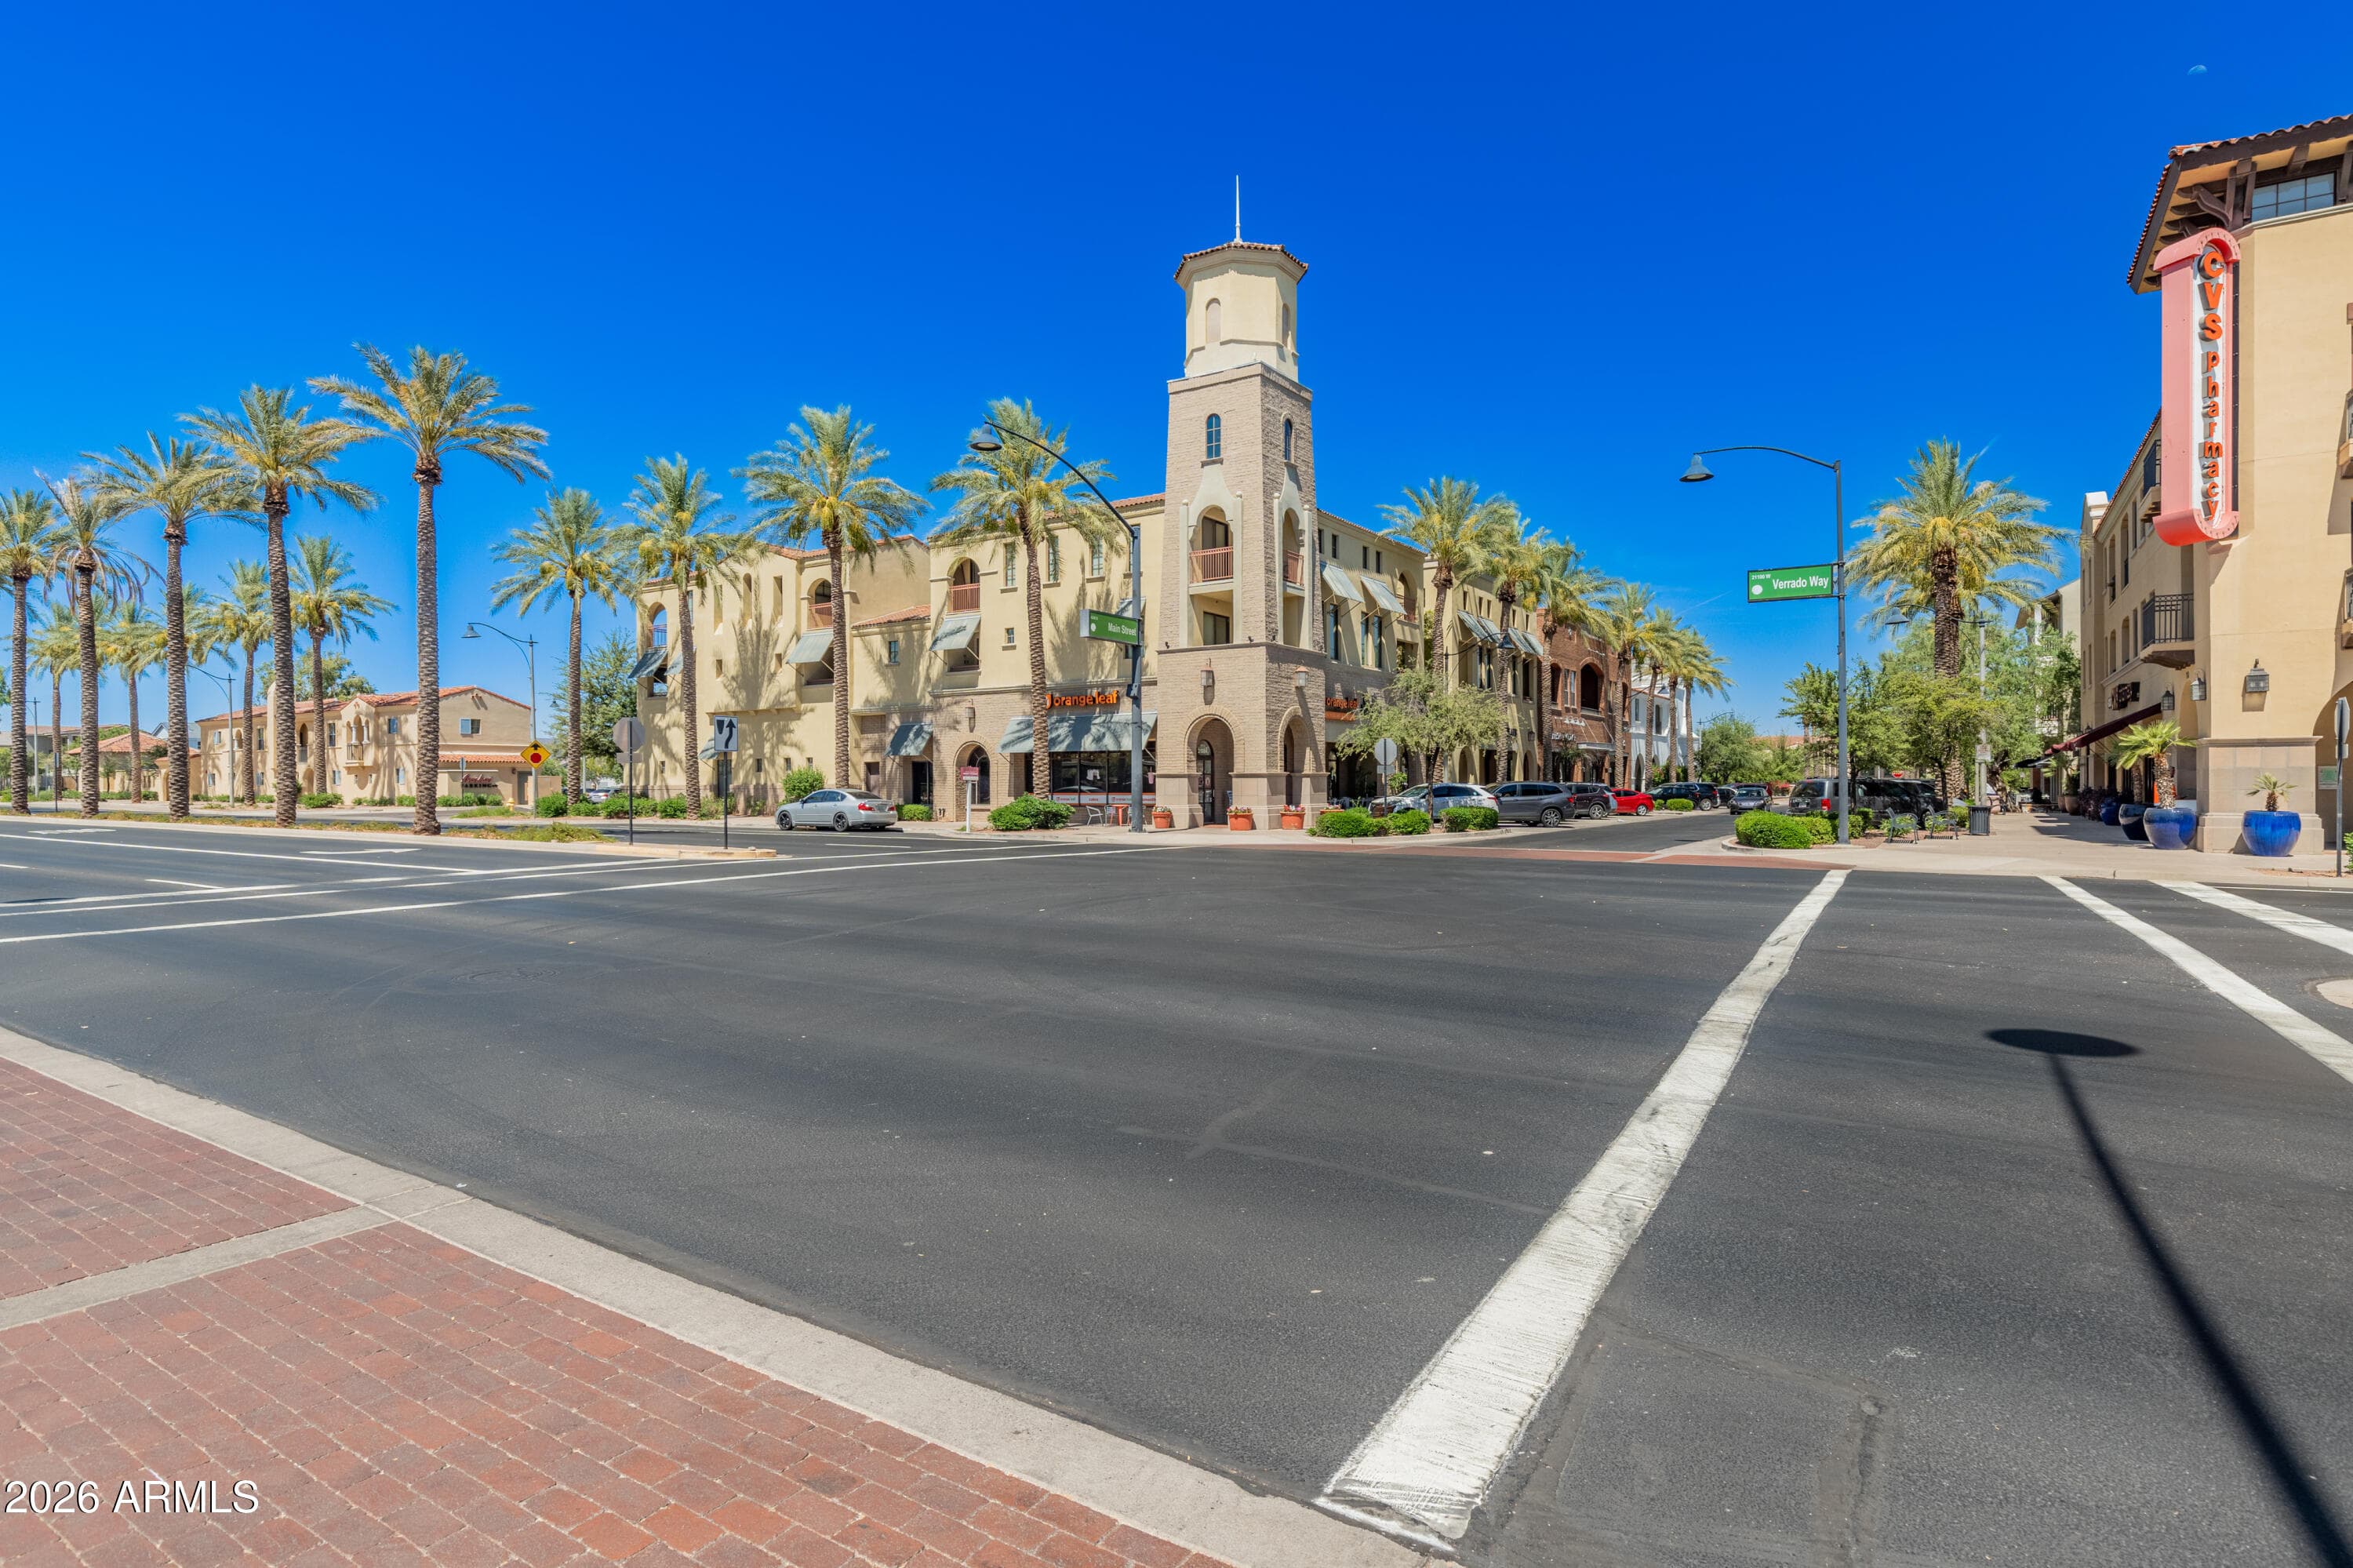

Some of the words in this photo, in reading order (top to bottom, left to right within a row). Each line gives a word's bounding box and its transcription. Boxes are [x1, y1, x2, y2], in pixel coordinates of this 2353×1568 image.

[2198, 251, 2224, 340] CVS
[2200, 351, 2223, 521] pharmacy
[1773, 577, 1807, 589] Verrado
[1809, 575, 1829, 588] Way
[1107, 622, 1121, 633] Main
[1121, 624, 1136, 636] Street
[1053, 695, 1093, 707] orange
[1094, 689, 1118, 704] leaf
[1326, 697, 1347, 708] orange
